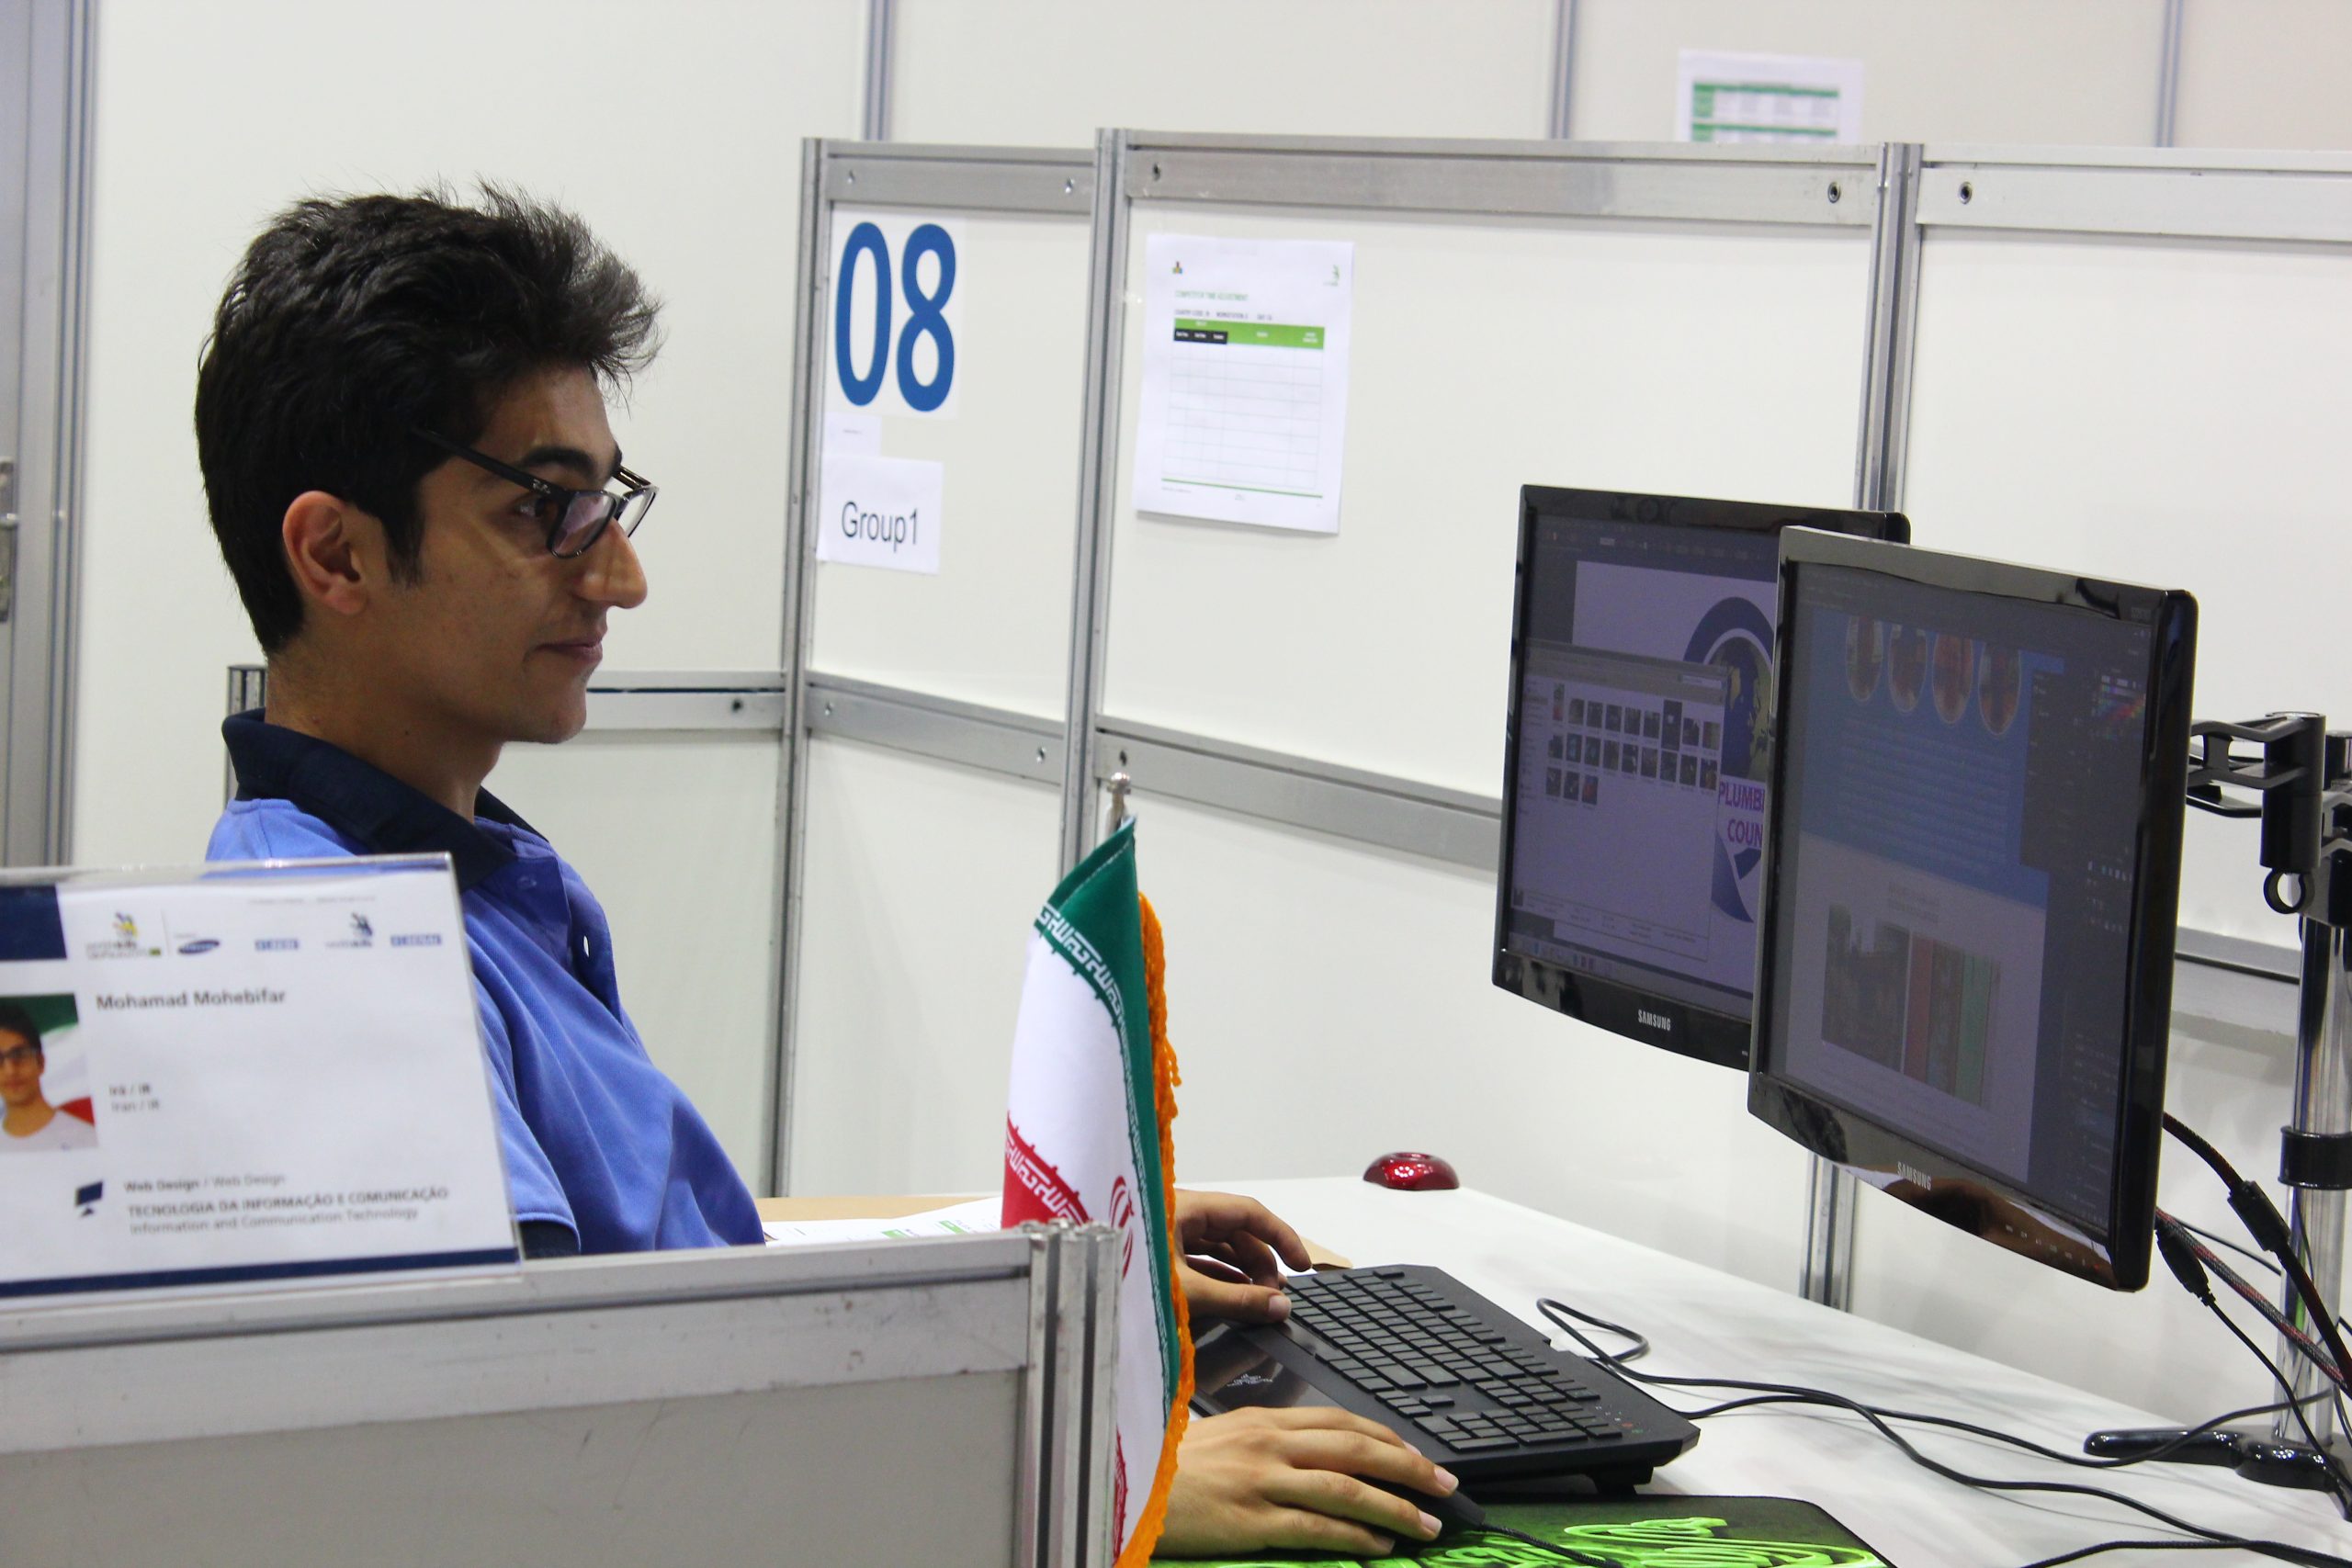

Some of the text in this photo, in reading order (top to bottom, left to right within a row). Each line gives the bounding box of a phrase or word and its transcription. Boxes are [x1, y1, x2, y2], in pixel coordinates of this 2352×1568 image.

[835, 221, 956, 412] 08
[842, 500, 918, 554] Group1
[96, 987, 285, 1010] Mohamad Mohebifar
[1638, 1009, 1671, 1032] SAMSUNG
[1897, 1161, 1931, 1191] SAMSUNG
